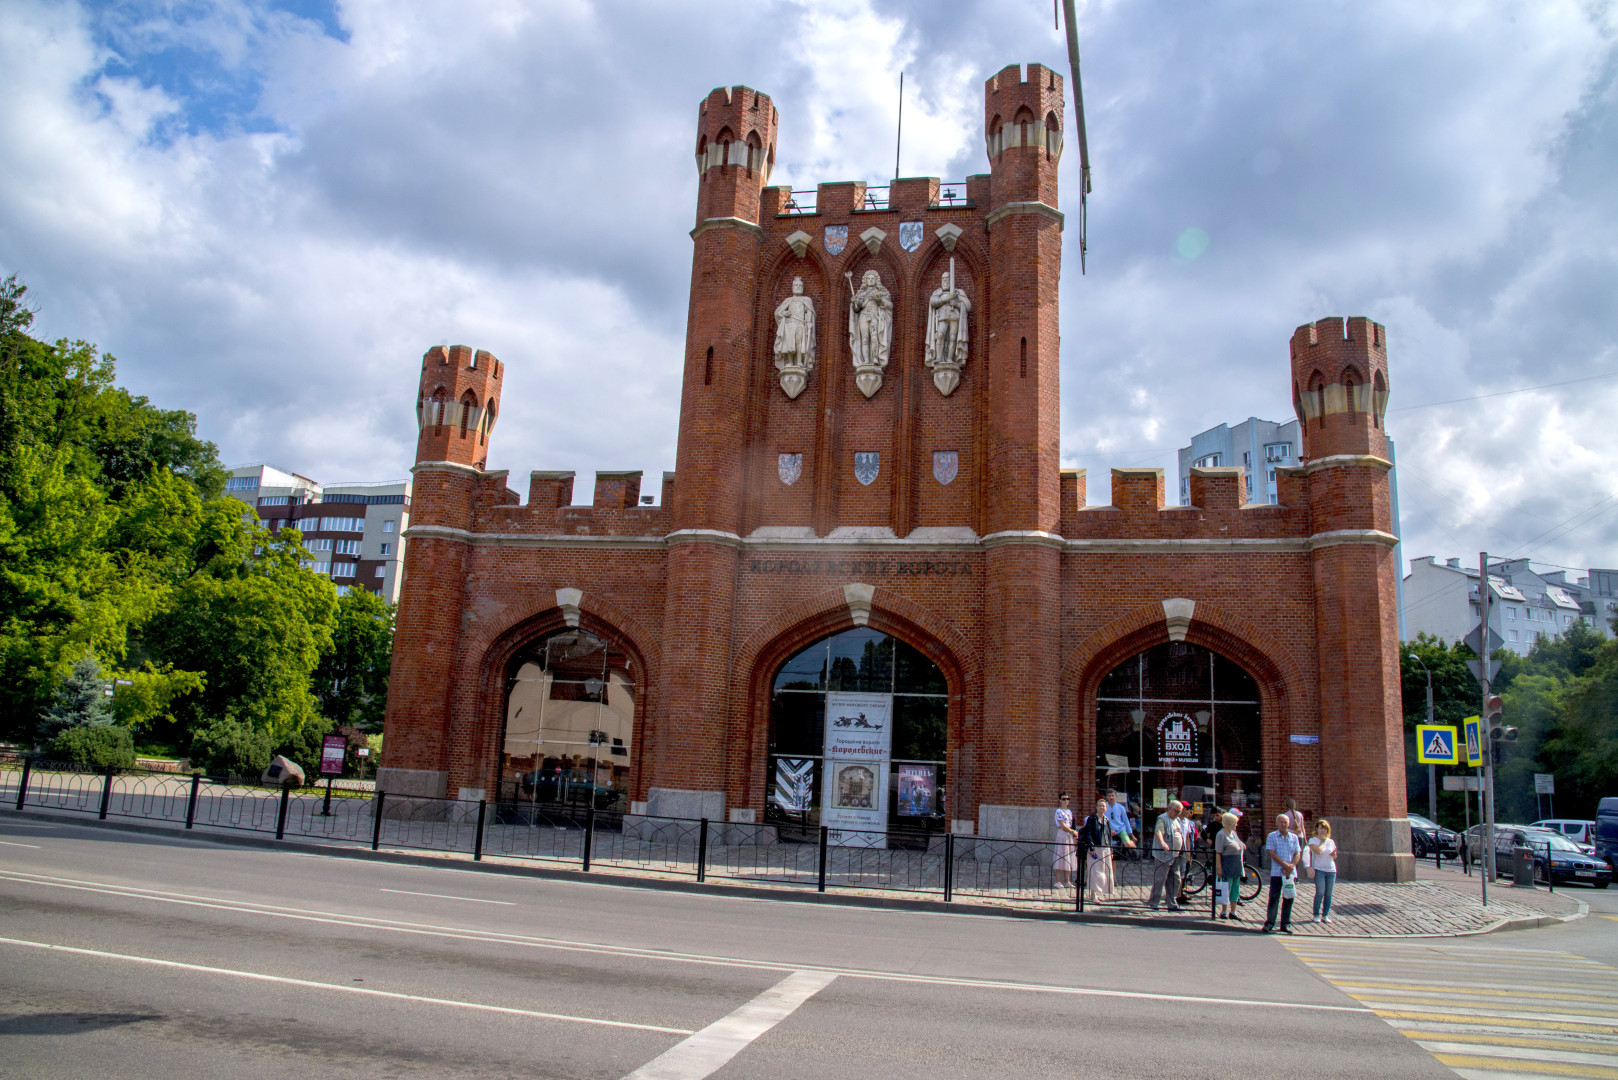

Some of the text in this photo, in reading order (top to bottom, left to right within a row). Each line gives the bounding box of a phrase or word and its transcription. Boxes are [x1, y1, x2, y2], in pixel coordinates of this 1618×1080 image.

[751, 559, 973, 575] КОРОЛЕВСКИЕ ВОРОТА
[1165, 743, 1191, 752] ВХОД
